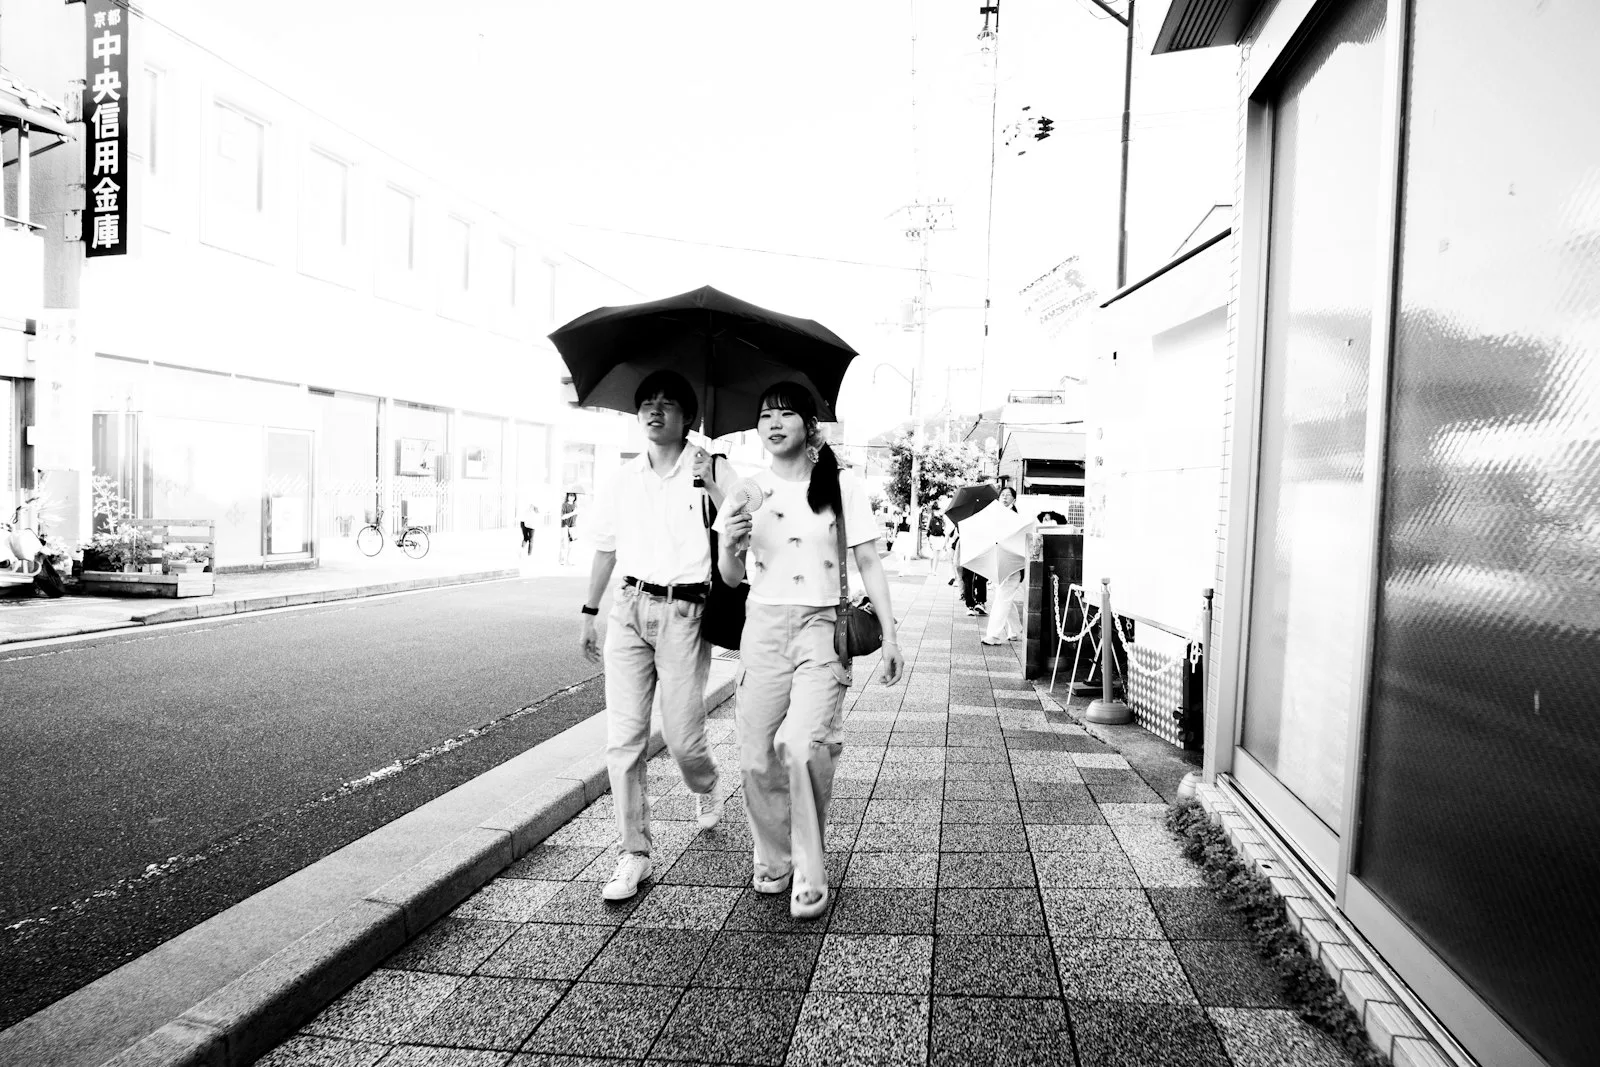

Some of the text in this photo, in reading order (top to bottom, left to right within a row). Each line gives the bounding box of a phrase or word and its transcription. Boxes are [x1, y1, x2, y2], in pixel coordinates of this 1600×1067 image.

[93, 9, 121, 28] 京都
[91, 30, 121, 249] 中央信用金庫
